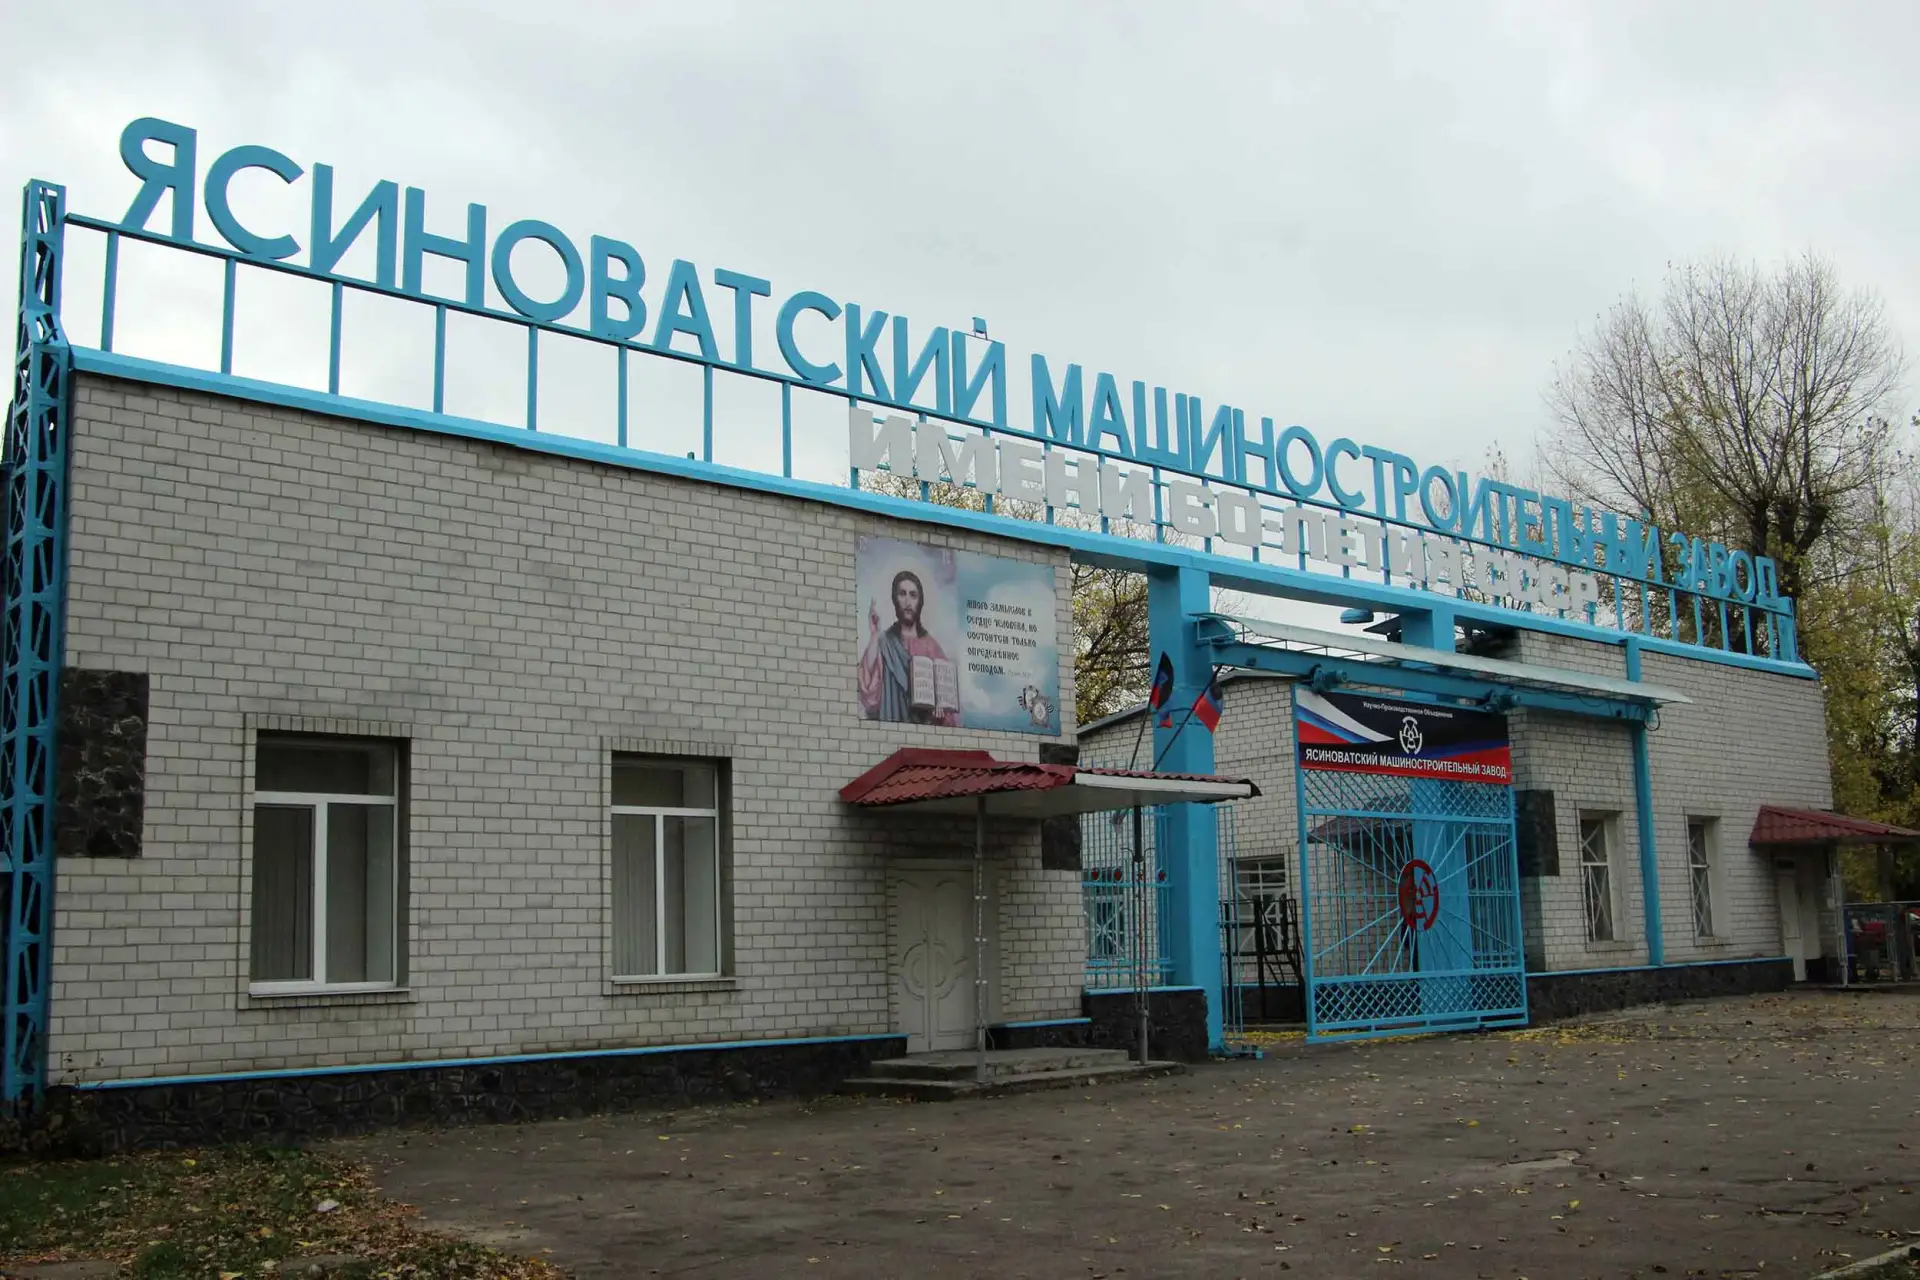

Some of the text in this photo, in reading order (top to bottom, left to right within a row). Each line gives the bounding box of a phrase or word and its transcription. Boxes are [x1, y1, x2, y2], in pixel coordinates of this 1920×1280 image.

[119, 116, 1788, 613] ЯСИНОВАТСКИЙ МАШИНОСТРОИТЕЛЬНЫЙ ЗАВОД
[850, 407, 1599, 611] ИМЕНИ 60-ЛЕТИЯ СССР
[1305, 748, 1507, 779] ЯСИНОВАТСКИЙ МАШИНОСТРОИТЕЛЬНЫЙ ЗАВОД
